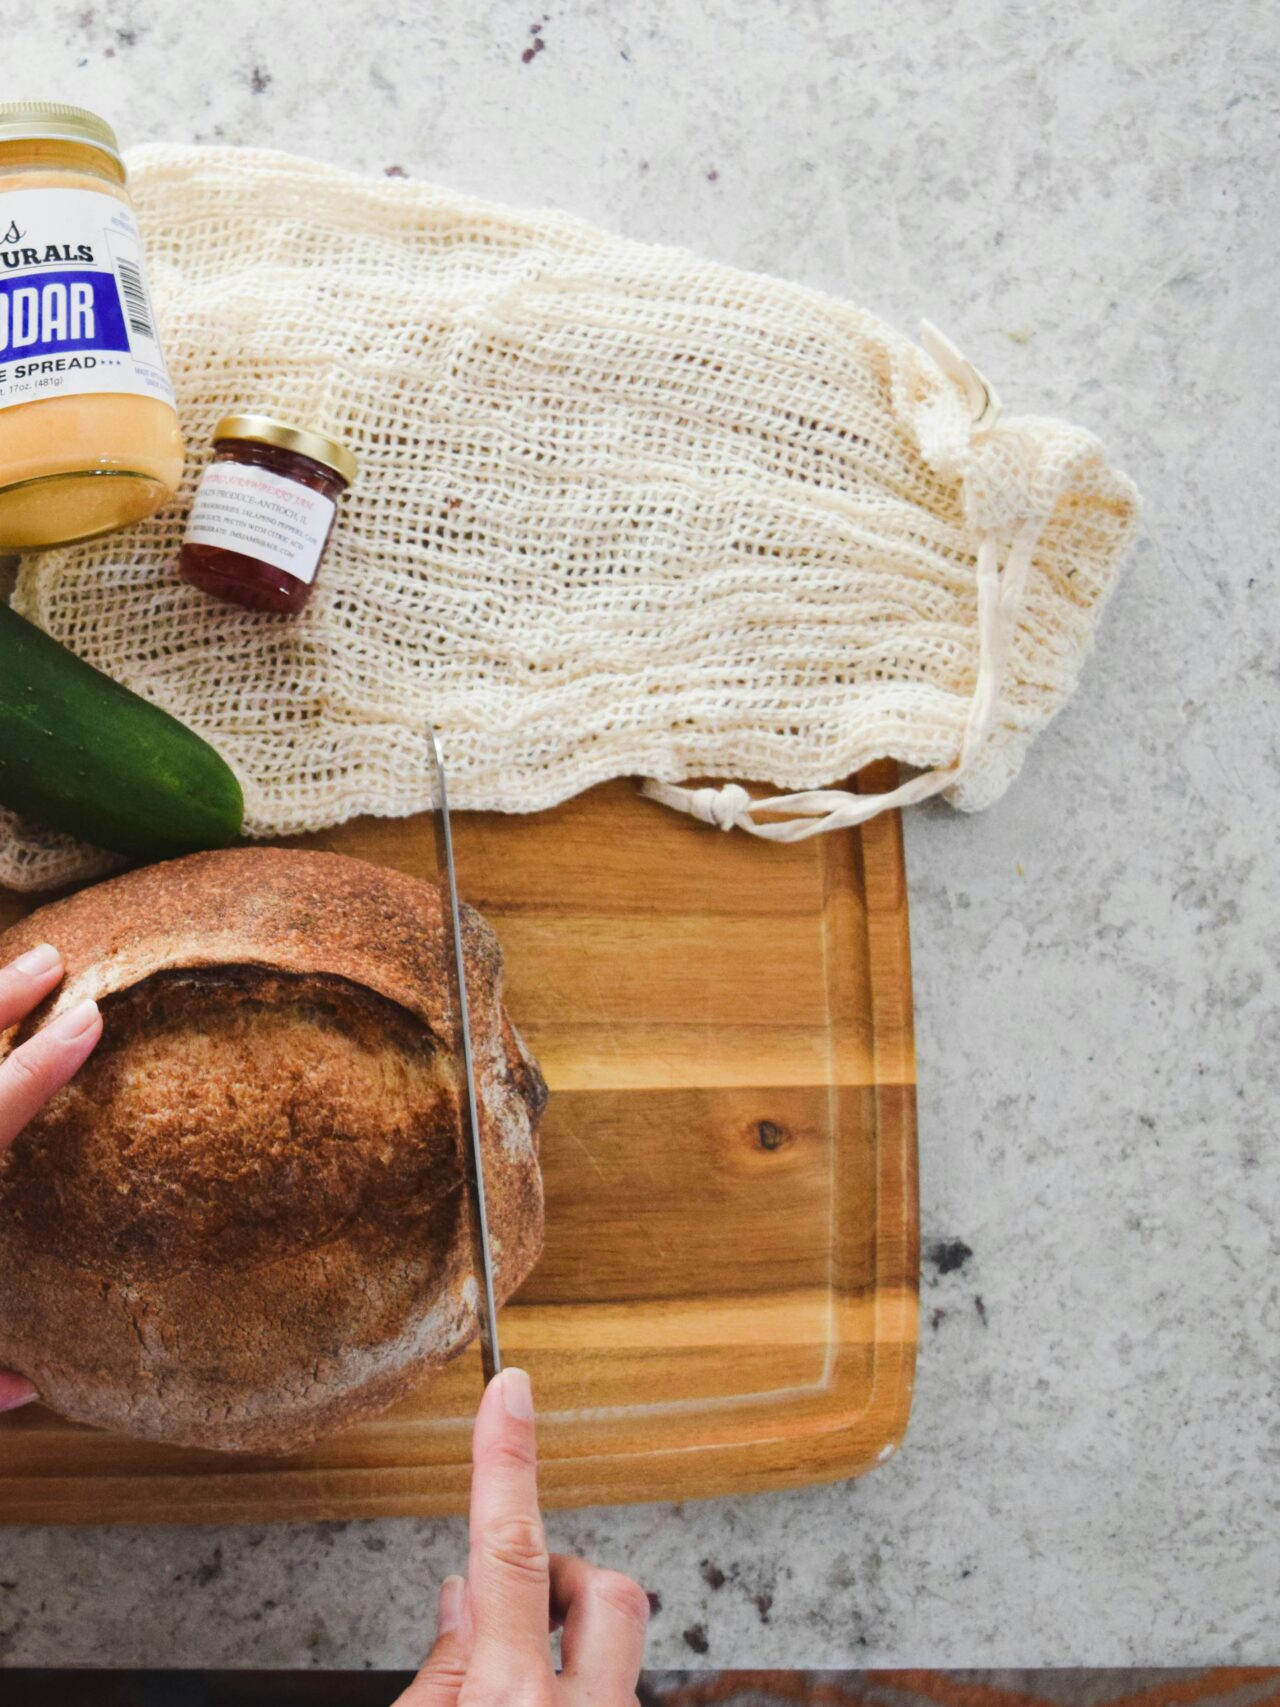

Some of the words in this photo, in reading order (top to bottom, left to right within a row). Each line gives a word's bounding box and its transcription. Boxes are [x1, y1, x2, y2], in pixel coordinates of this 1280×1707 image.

[14, 356, 97, 379] SPREAD
[9, 383, 32, 393] 17oz.
[35, 376, 64, 389] (481g)
